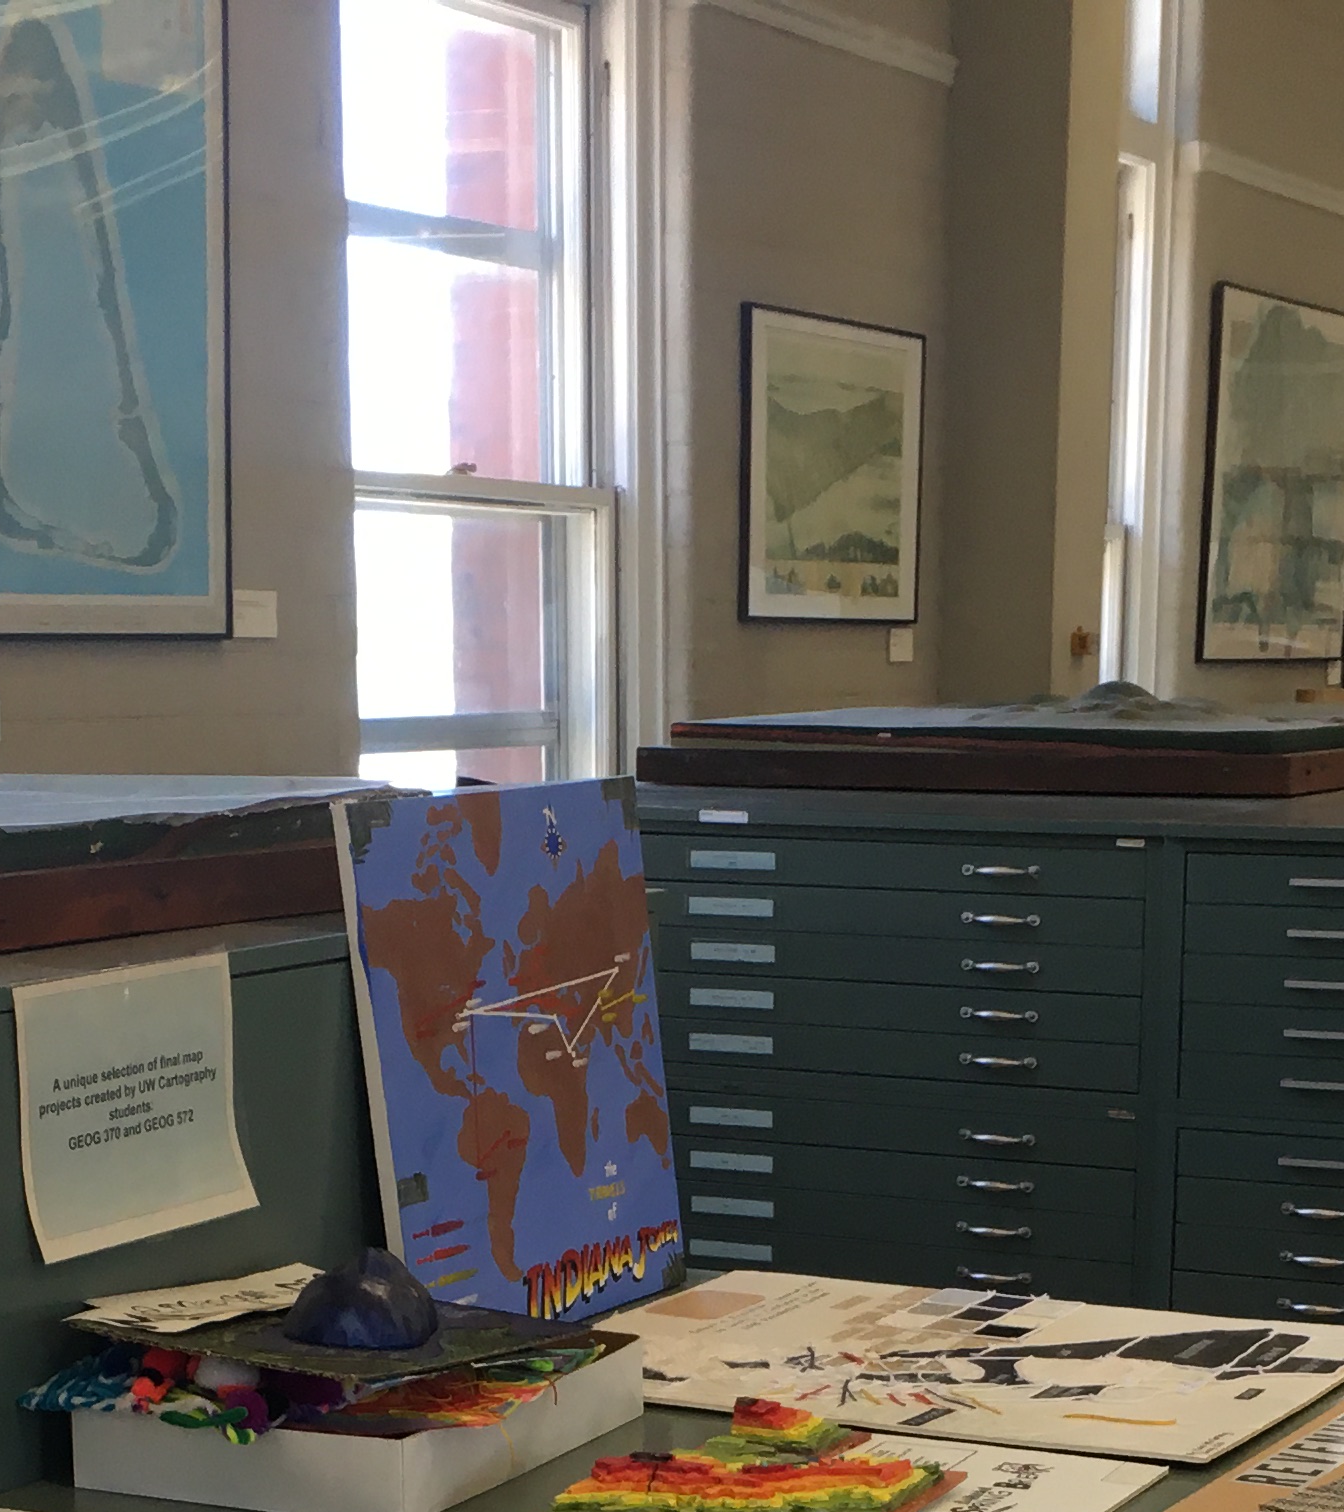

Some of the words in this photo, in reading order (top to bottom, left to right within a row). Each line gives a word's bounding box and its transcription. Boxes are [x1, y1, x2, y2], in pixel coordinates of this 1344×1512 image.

[38, 1096, 82, 1119] projects
[84, 1085, 122, 1106] created
[124, 1083, 136, 1100] by
[138, 1077, 157, 1094] UW
[158, 1066, 217, 1090] Cartography
[52, 1078, 62, 1092] A
[63, 1074, 98, 1090] unique
[101, 1062, 145, 1081] selection
[147, 1057, 158, 1072] of
[159, 1053, 181, 1069] final
[182, 1050, 203, 1067] map
[68, 1131, 102, 1150] GEOG
[103, 1126, 121, 1143] 370
[123, 1122, 142, 1138] and
[143, 1114, 175, 1132] GEOG
[176, 1109, 194, 1125] 572
[524, 1234, 634, 1321] INDIANA
